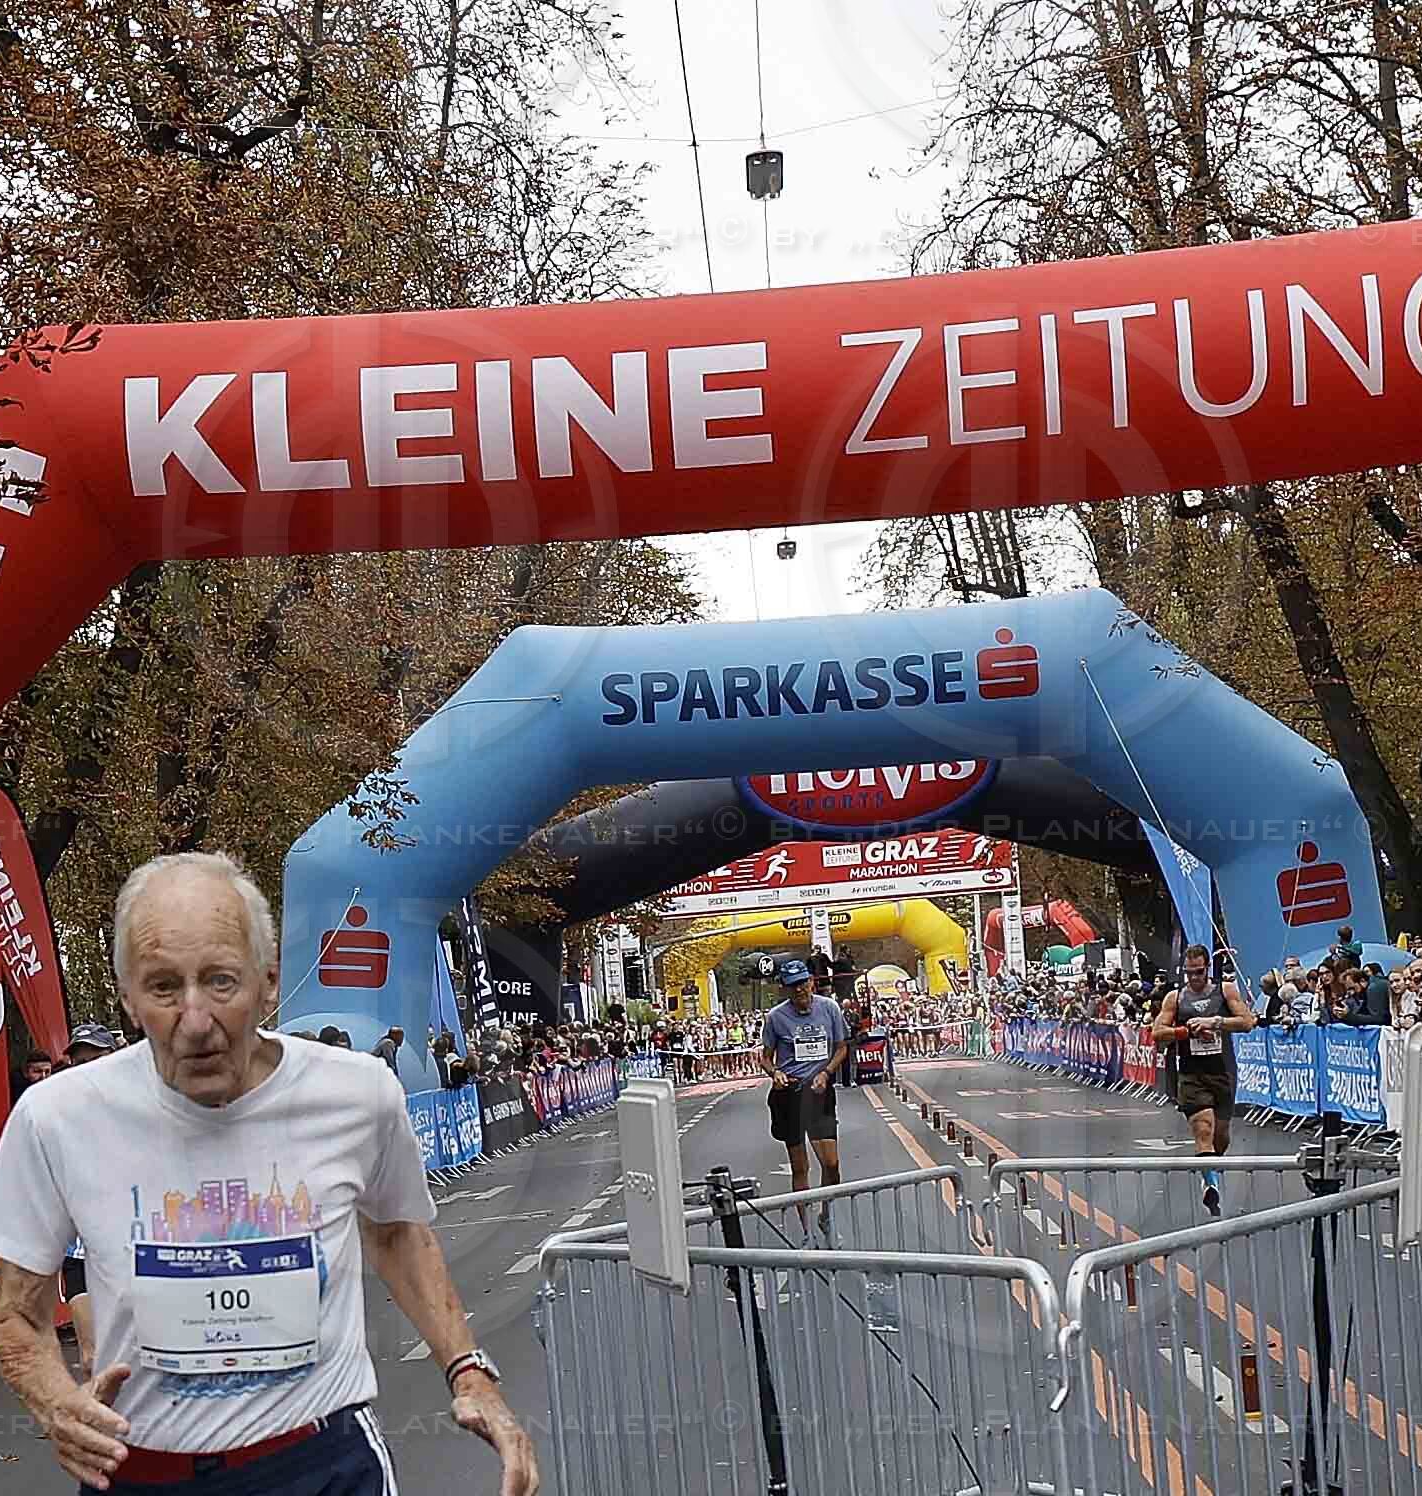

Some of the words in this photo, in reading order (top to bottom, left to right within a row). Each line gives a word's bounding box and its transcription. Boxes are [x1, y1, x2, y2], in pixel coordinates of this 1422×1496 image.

[123, 340, 774, 497] KLEINE
[601, 649, 967, 727] SPARKASSE
[864, 836, 939, 864] GRAZ
[849, 862, 918, 880] MARATHON
[493, 979, 532, 996] TORE
[205, 1288, 251, 1312] 100
